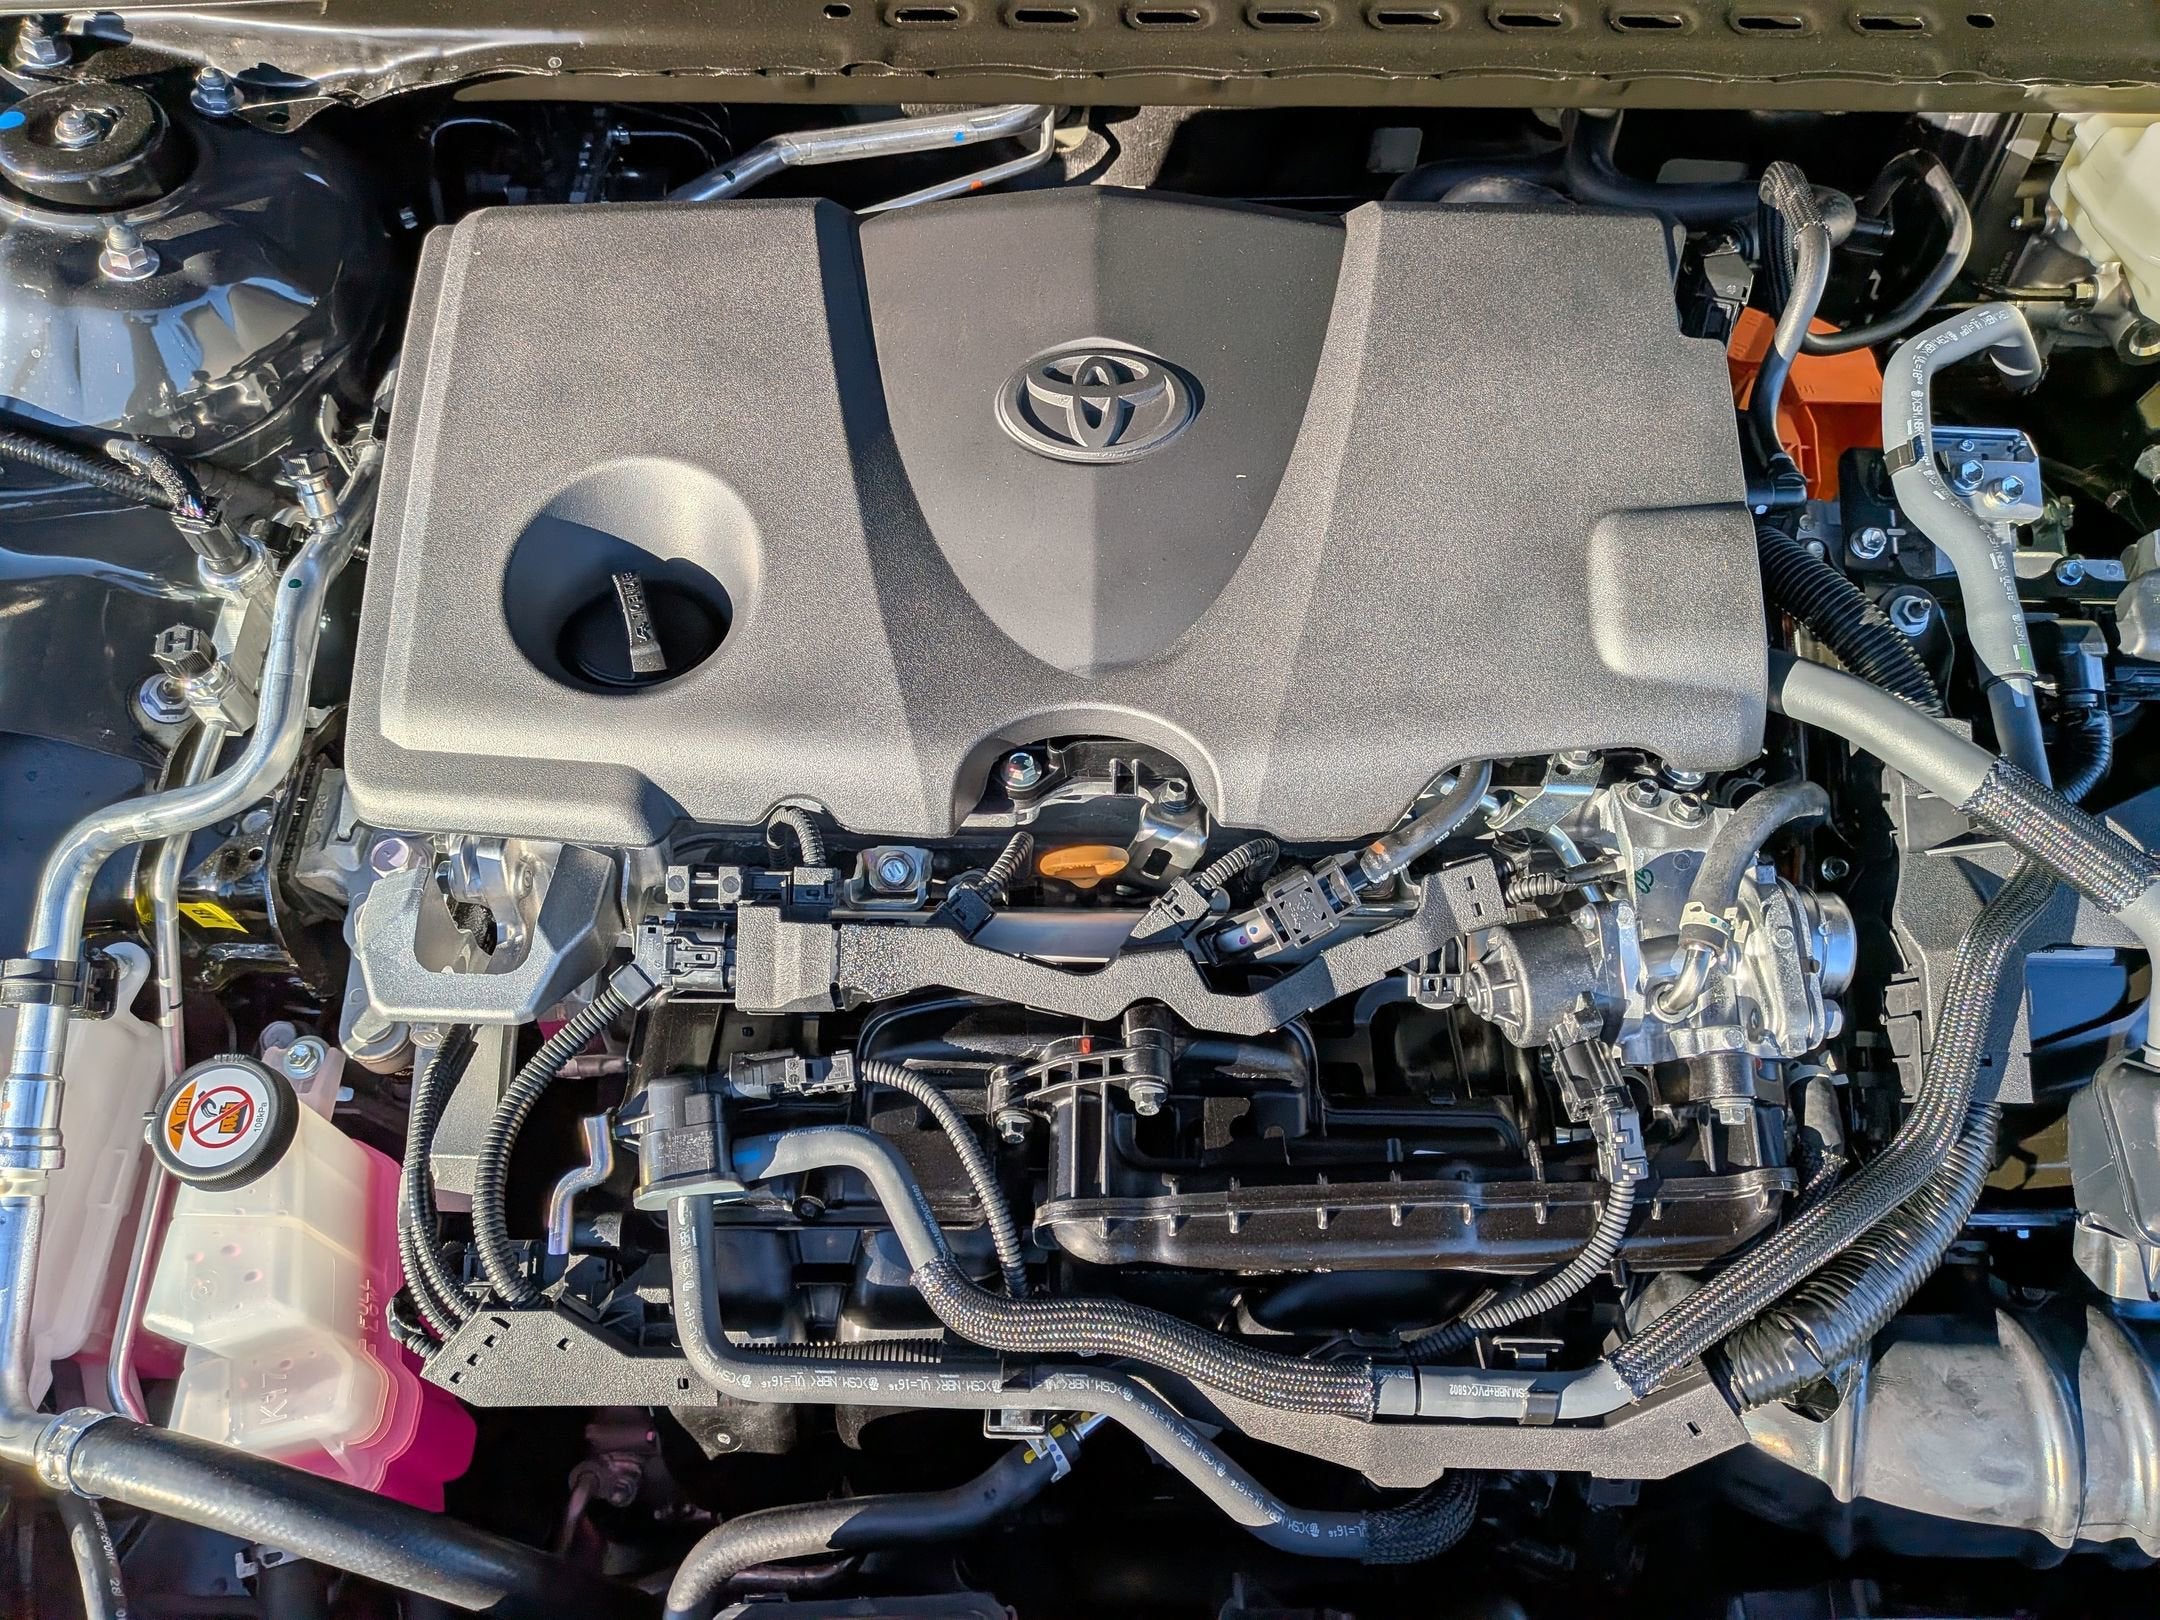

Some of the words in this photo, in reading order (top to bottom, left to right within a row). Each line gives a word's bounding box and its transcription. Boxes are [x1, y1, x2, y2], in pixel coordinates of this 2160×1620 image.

[163, 629, 194, 653] H
[253, 1101, 268, 1133] 108kPa
[358, 1279, 370, 1330] FULL
